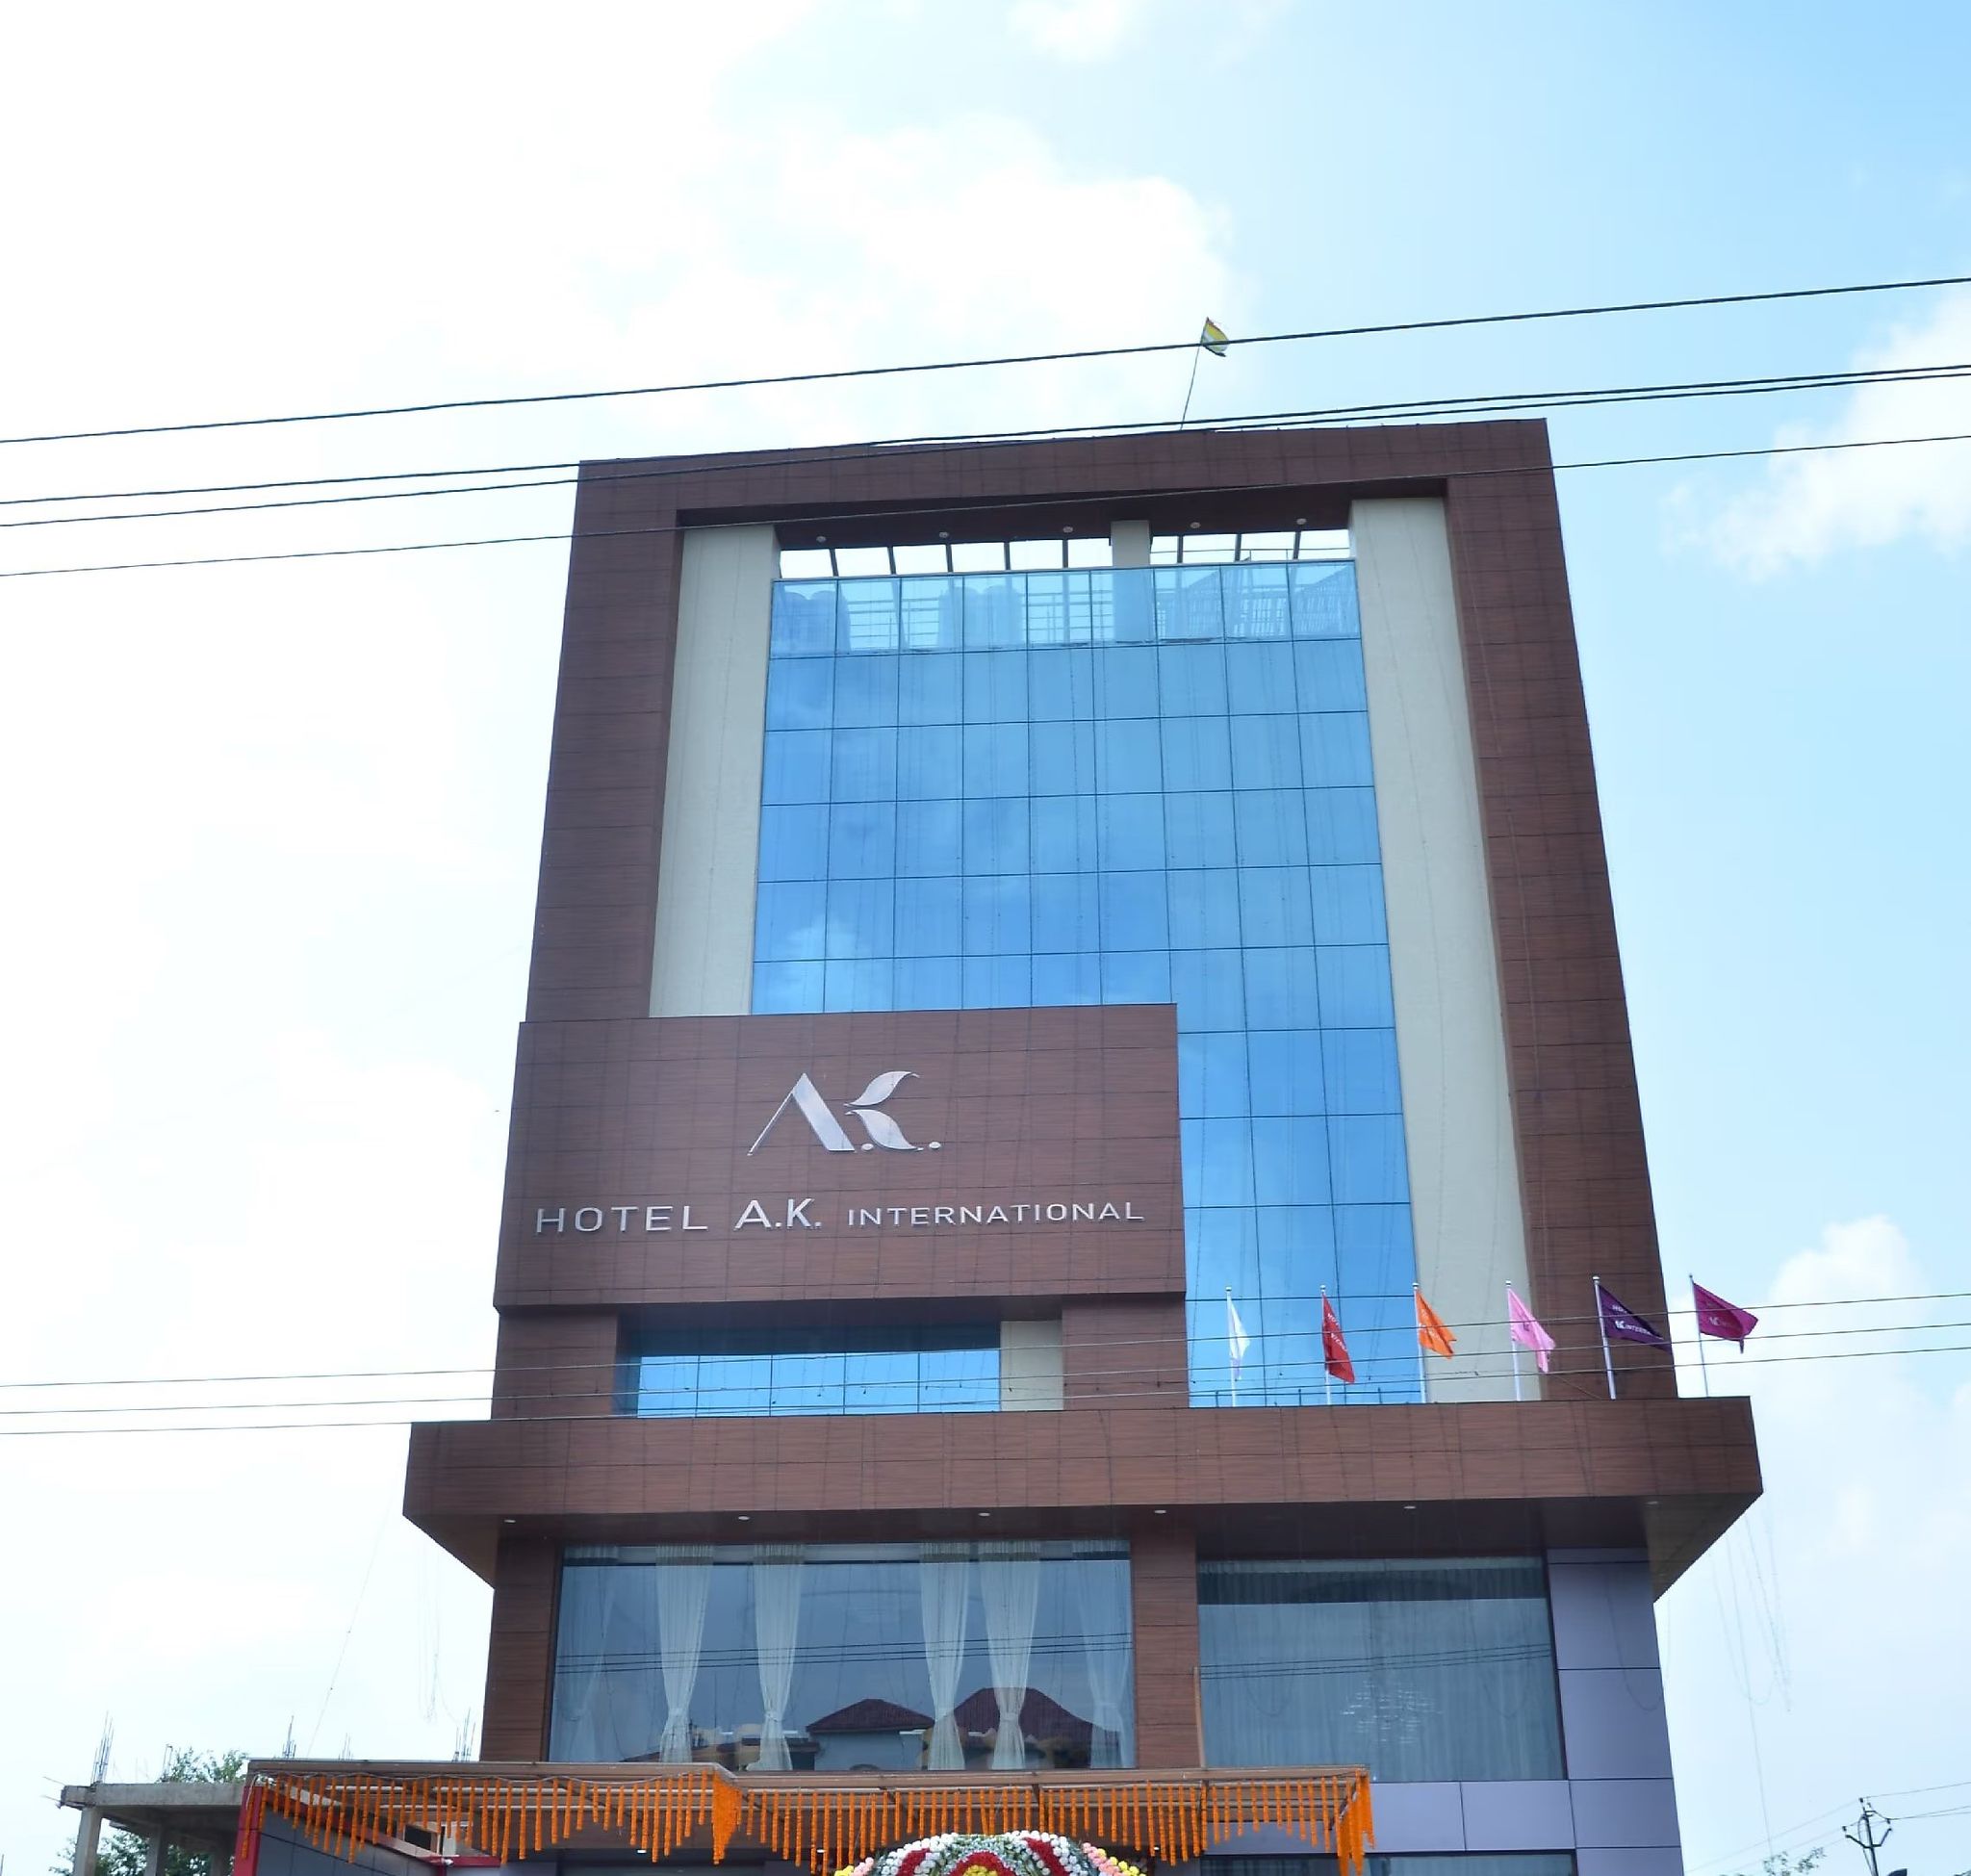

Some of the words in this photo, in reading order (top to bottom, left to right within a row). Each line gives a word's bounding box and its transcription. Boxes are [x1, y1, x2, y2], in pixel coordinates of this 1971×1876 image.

[536, 1205, 708, 1233] HOTEL
[733, 1197, 823, 1230] A.K.
[848, 1201, 1145, 1226] INTERNATIONAL
